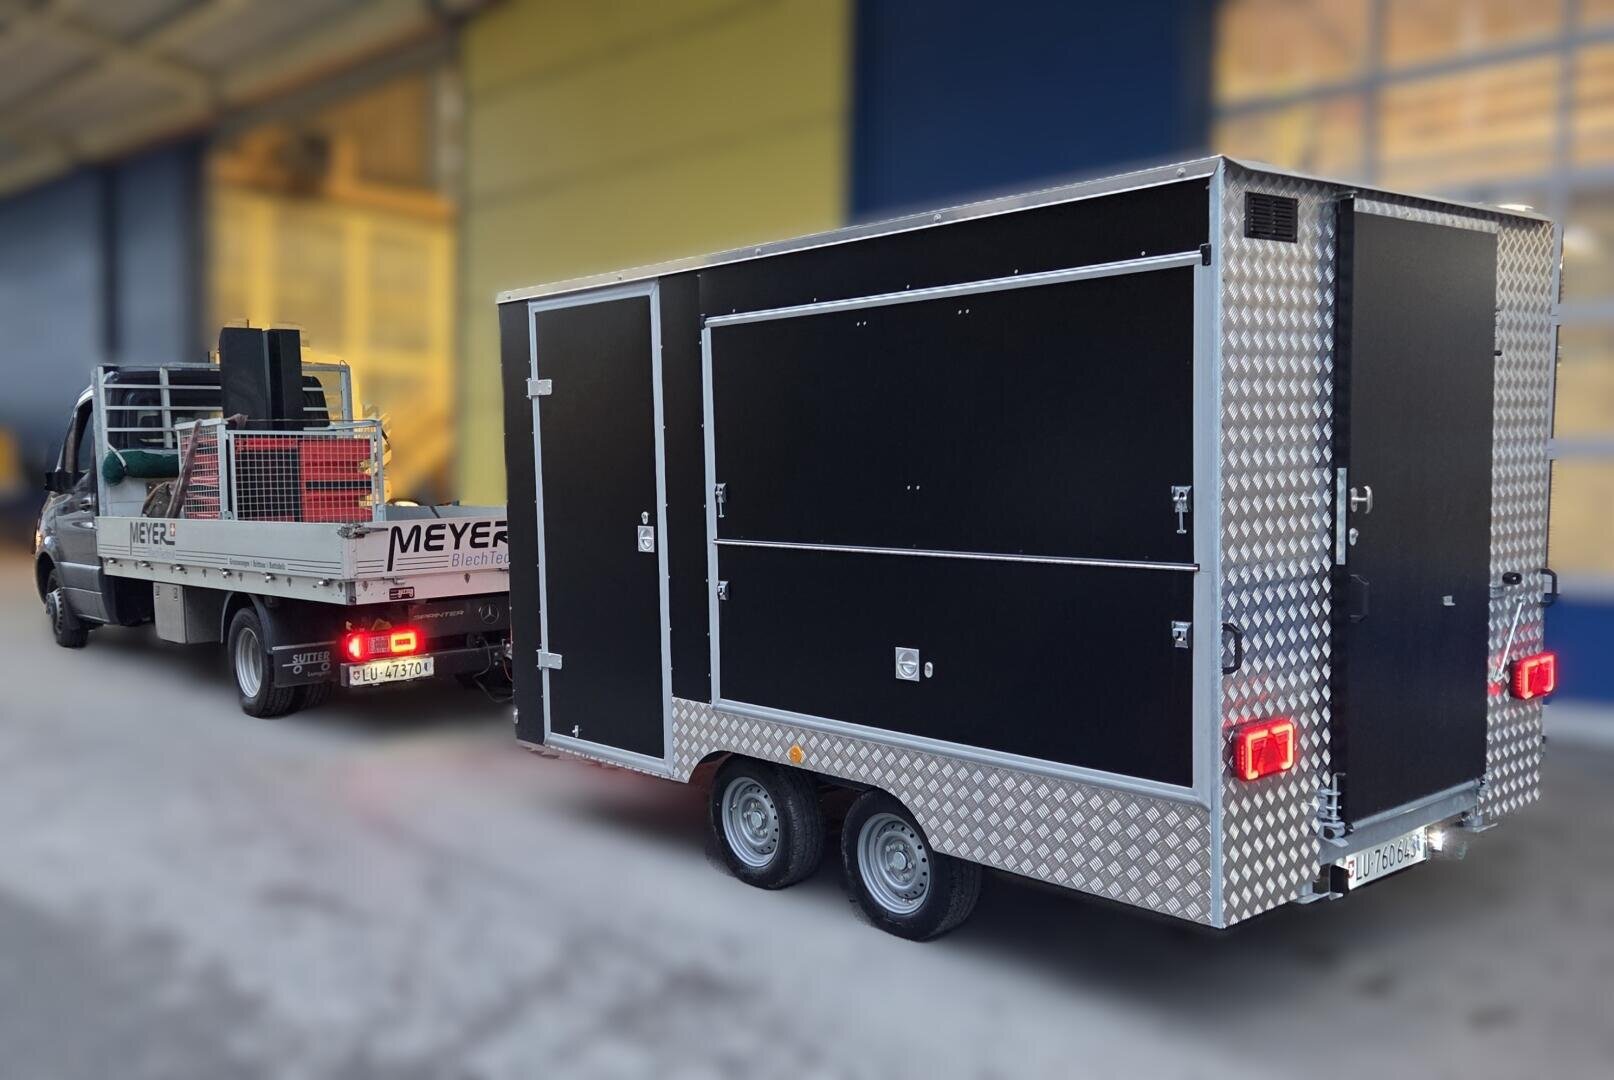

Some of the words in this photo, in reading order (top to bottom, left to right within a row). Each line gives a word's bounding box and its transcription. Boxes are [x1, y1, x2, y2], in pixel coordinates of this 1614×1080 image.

[129, 521, 175, 556] MEYER
[387, 520, 508, 572] MEYER
[292, 651, 330, 664] SUTTER
